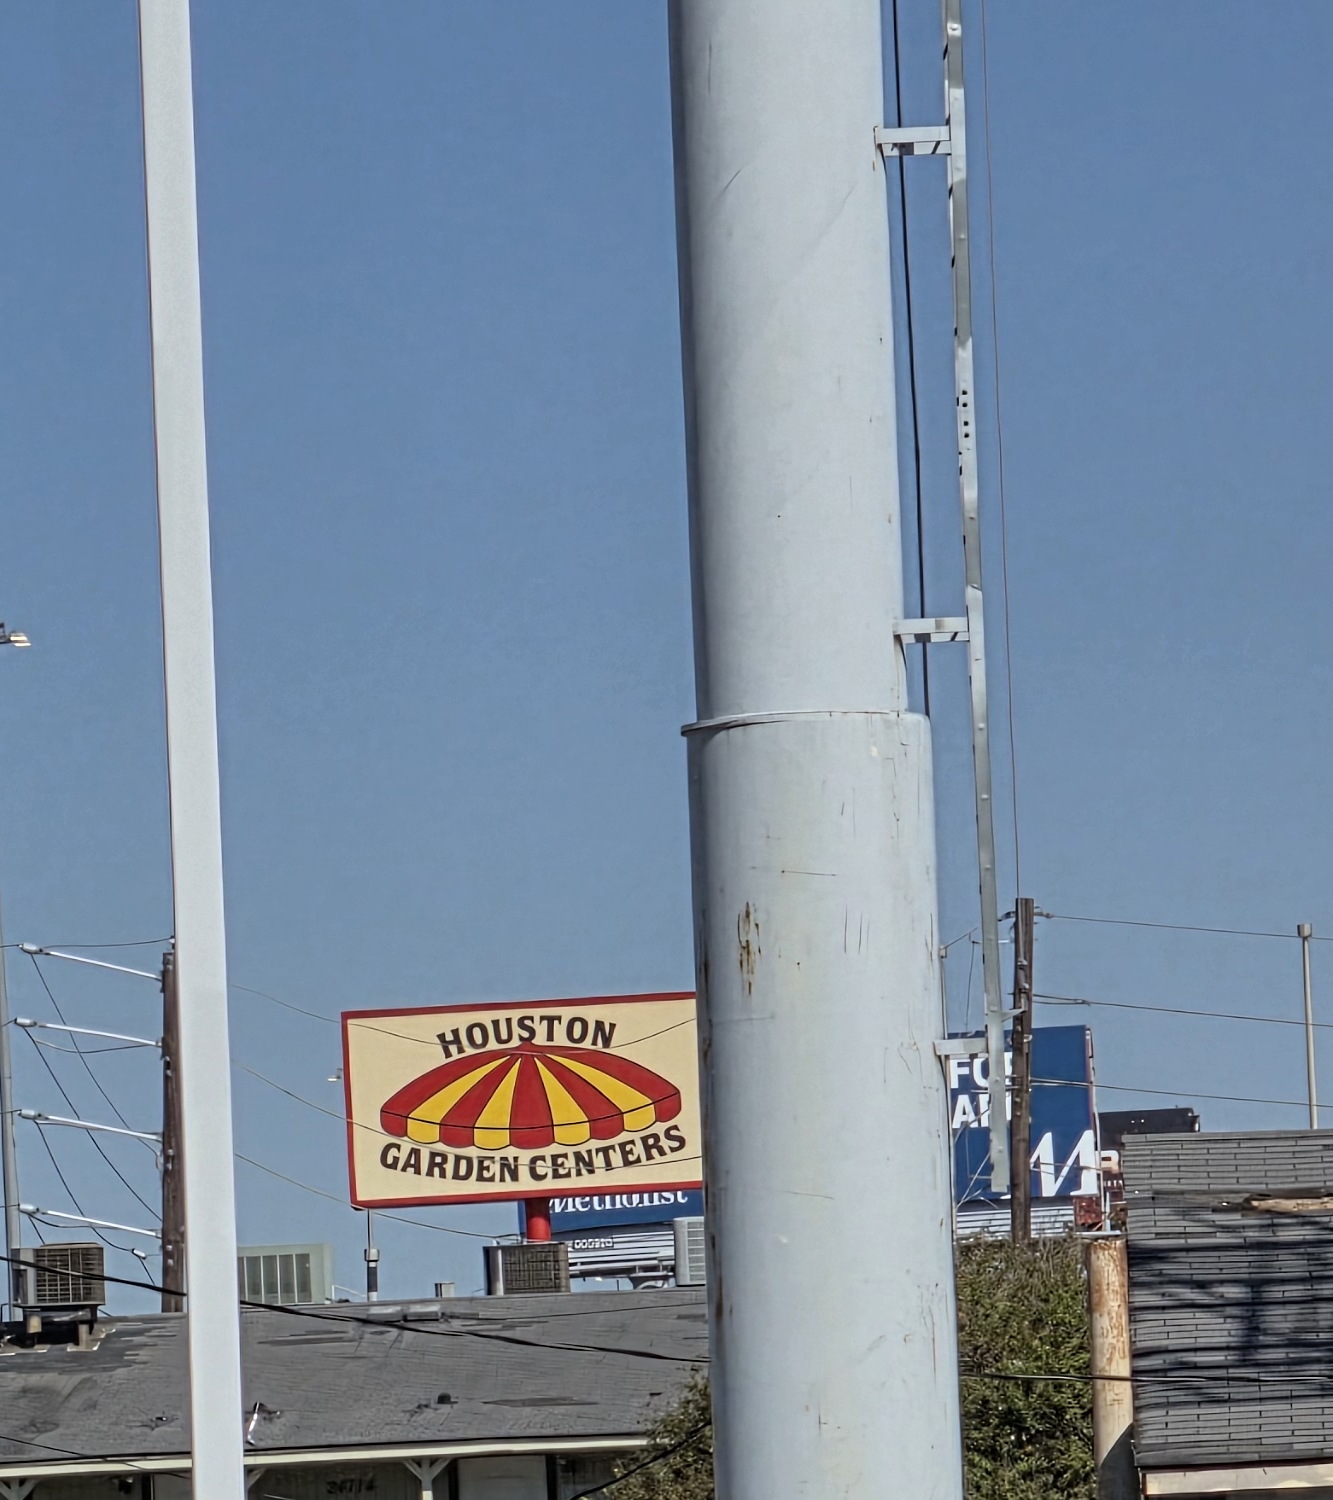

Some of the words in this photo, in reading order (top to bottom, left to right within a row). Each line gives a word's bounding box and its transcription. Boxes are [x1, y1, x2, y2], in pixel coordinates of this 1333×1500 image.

[436, 1015, 617, 1059] HOUSTON
[380, 1142, 520, 1182] GARDEN
[528, 1124, 687, 1181] CENTERS
